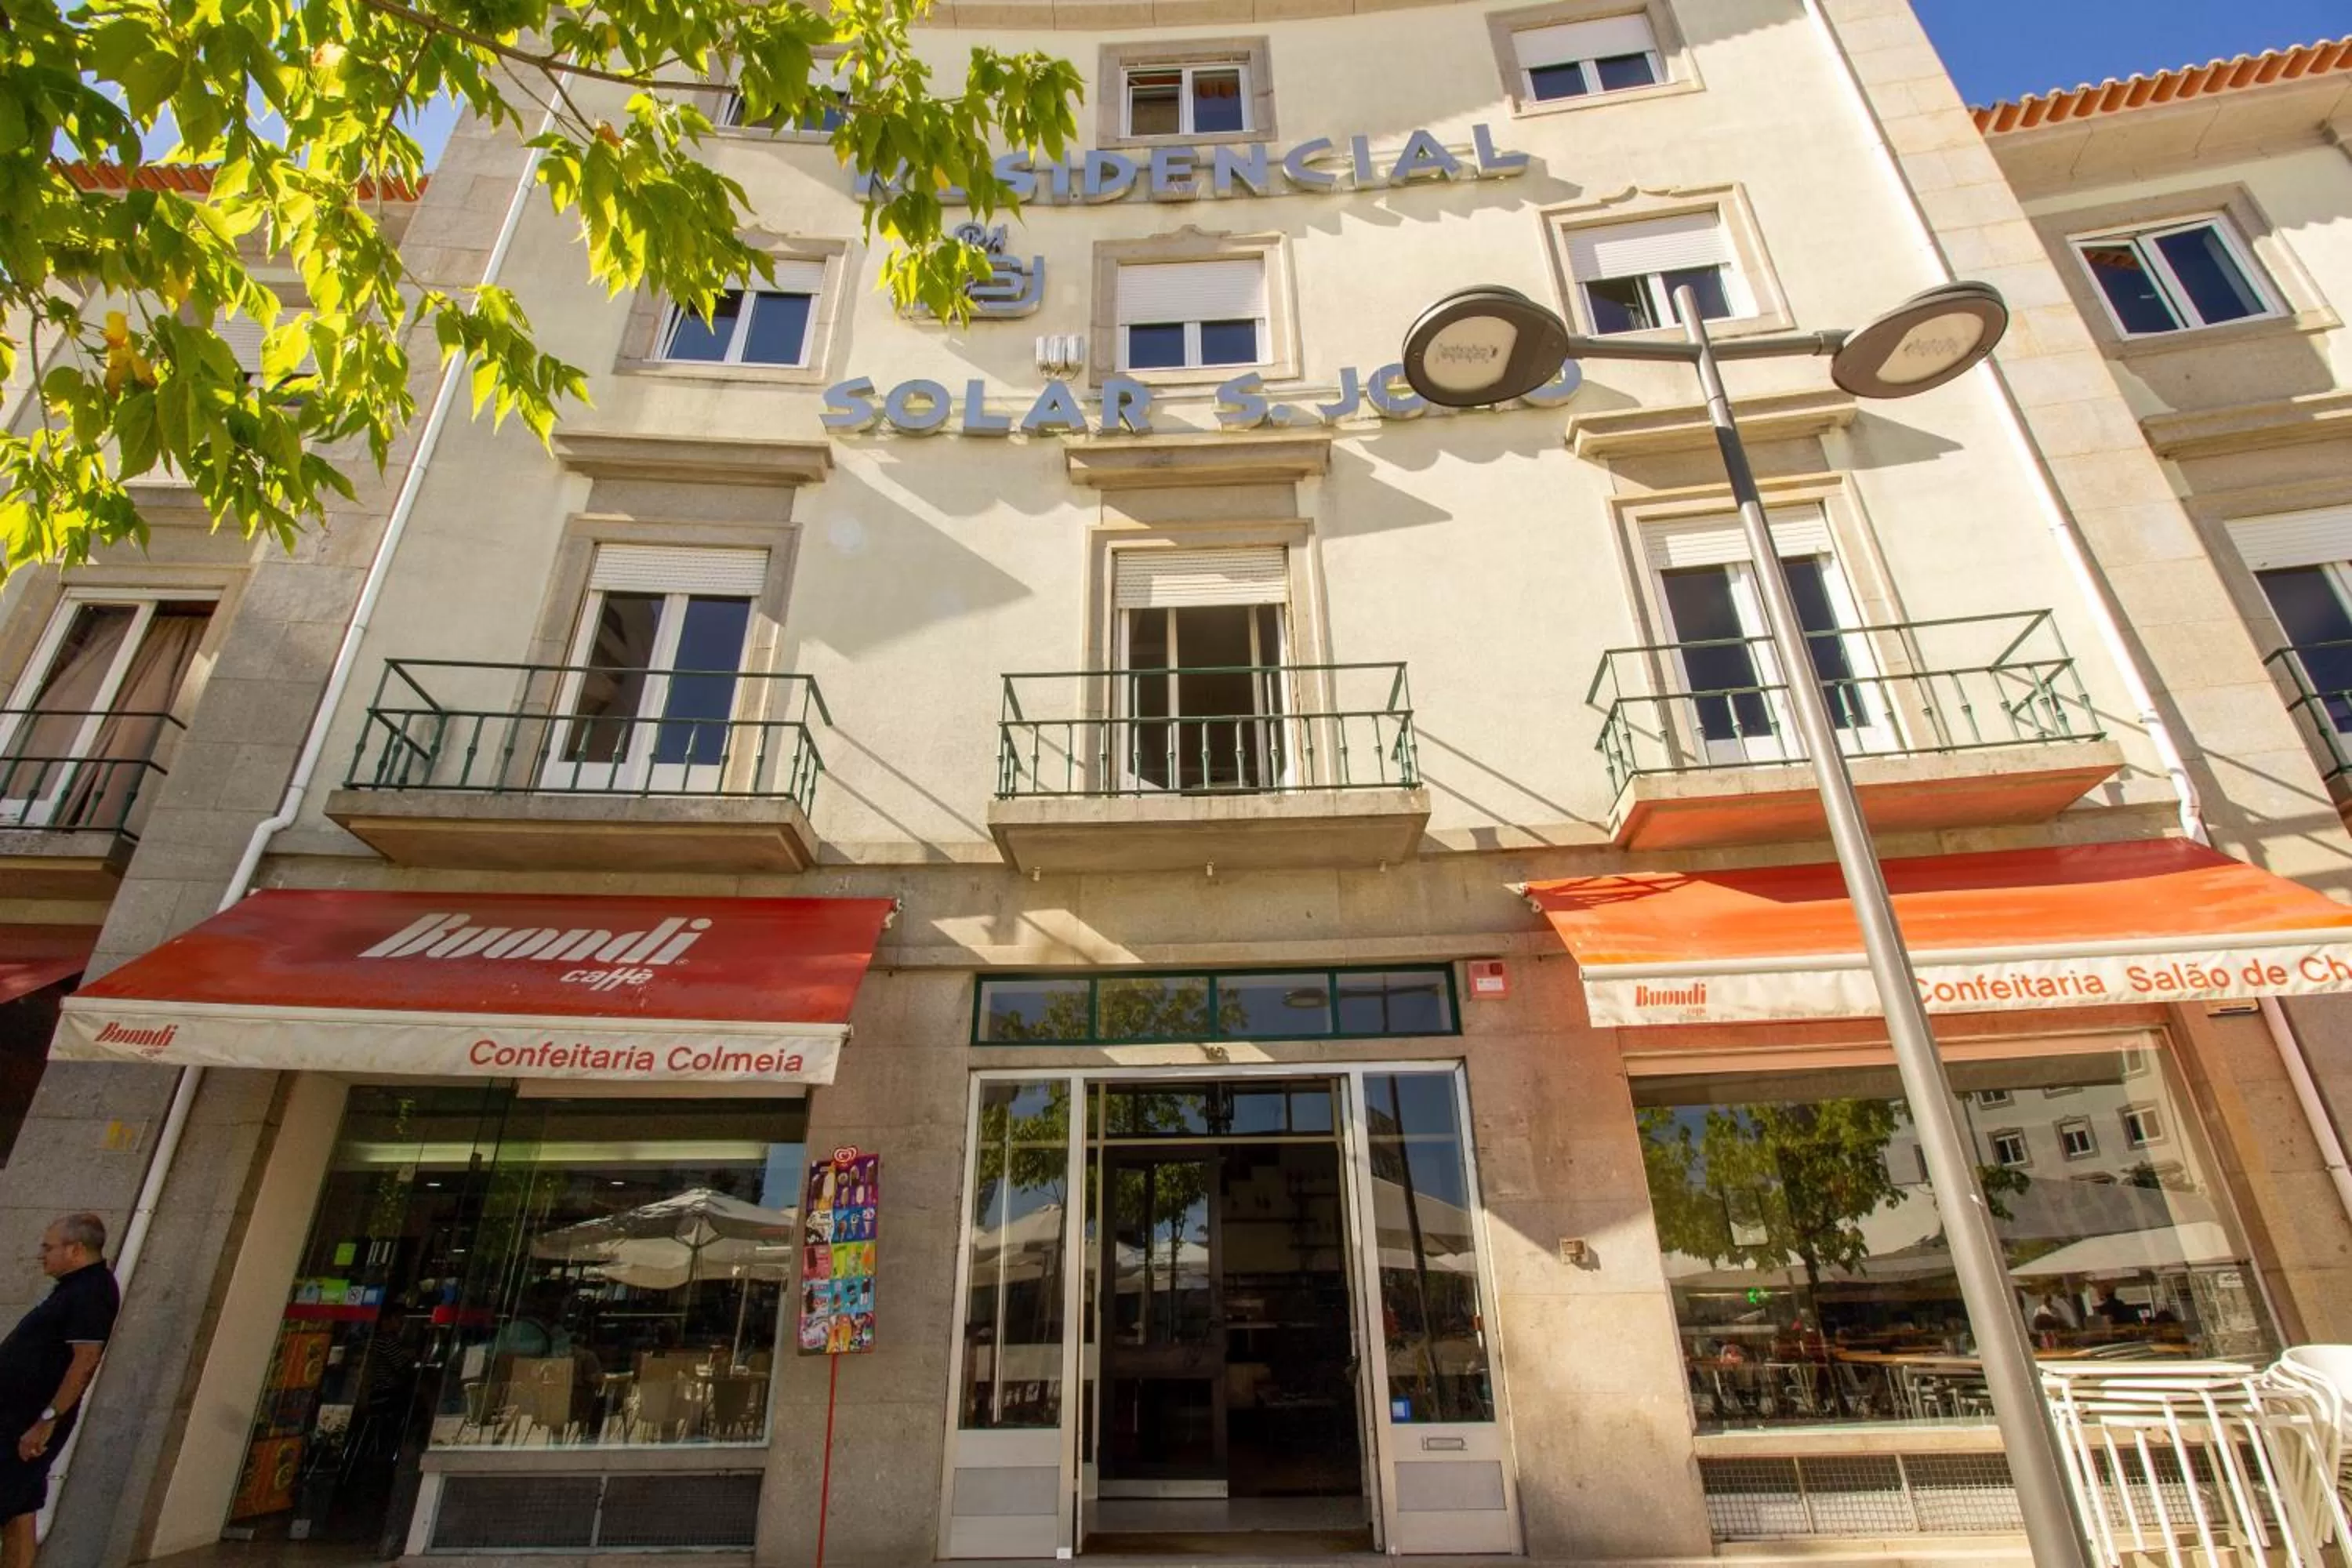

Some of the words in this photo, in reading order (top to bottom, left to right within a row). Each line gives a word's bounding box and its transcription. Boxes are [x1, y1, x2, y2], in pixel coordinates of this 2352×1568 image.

[851, 123, 1530, 205] SIDENCIAL
[819, 376, 1153, 437] SOLAR
[1214, 372, 1292, 431] S.
[1317, 358, 1583, 426] JOO
[358, 913, 713, 965] Buondi
[559, 967, 654, 992] caffè
[2126, 961, 2231, 994] Salão
[2241, 958, 2288, 987] de
[2299, 954, 2352, 982] Ch
[1635, 982, 1707, 1007] Buondi
[94, 1021, 179, 1047] Buondi
[470, 1040, 655, 1072] Confeitaria
[666, 1046, 804, 1073] Colmeia
